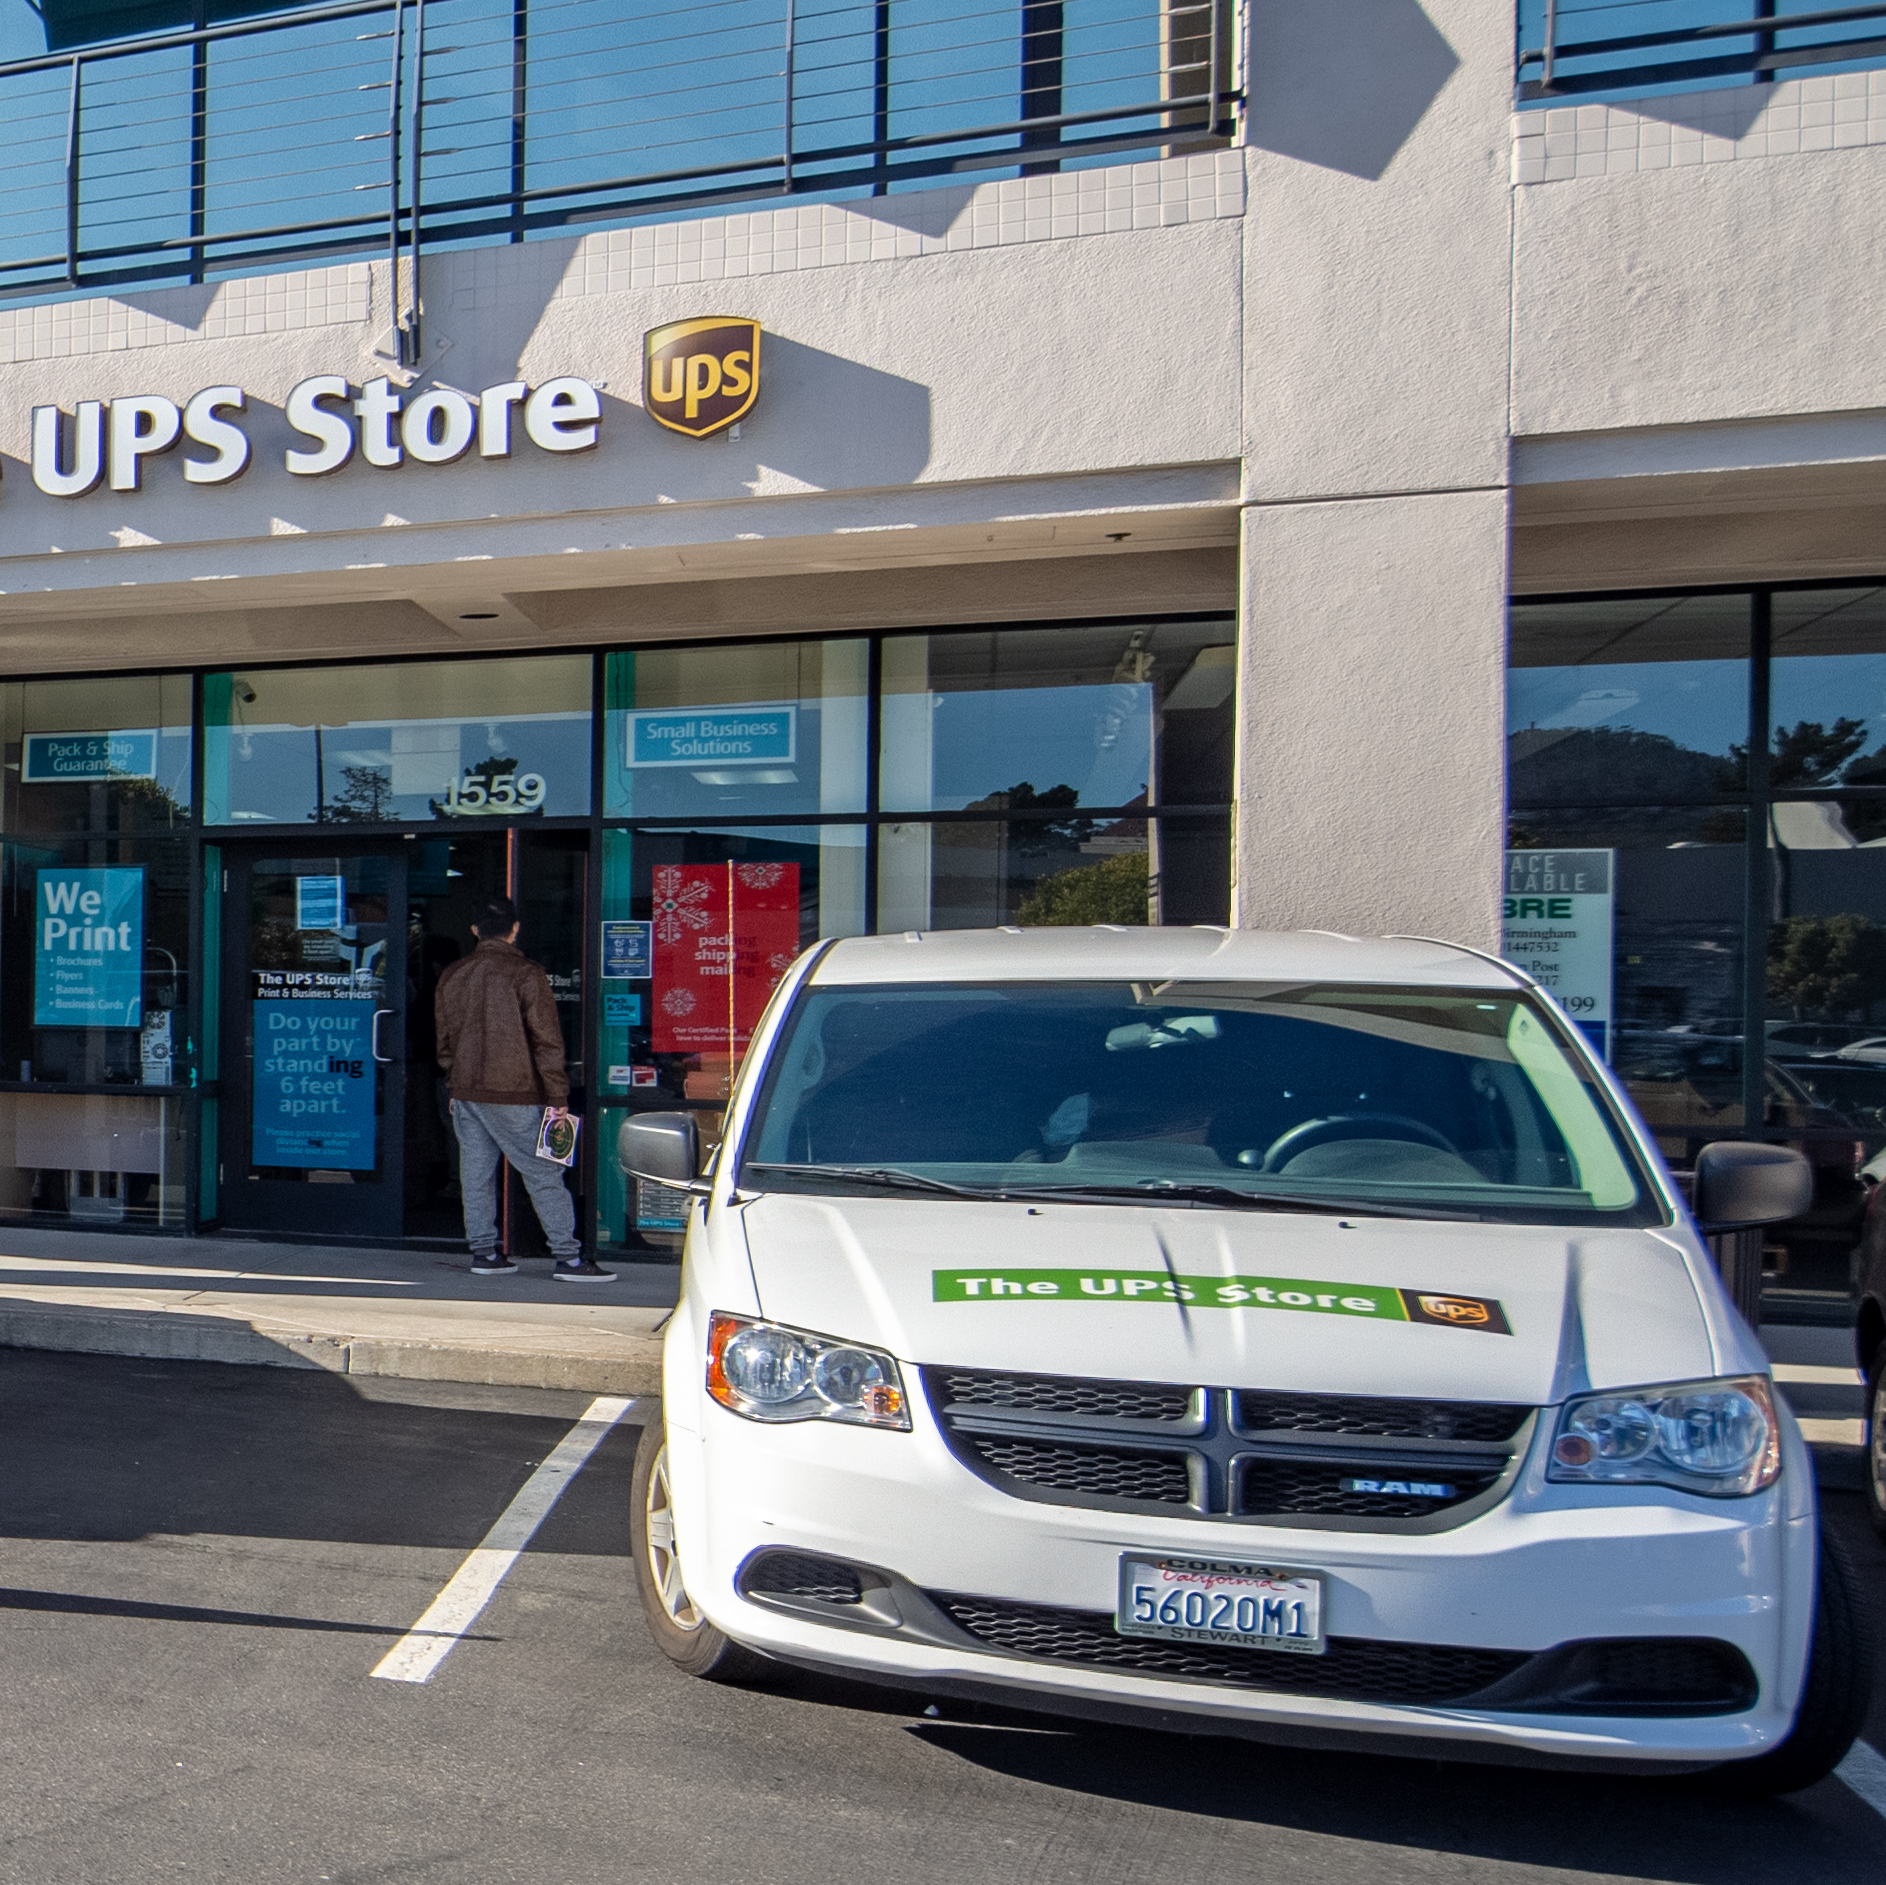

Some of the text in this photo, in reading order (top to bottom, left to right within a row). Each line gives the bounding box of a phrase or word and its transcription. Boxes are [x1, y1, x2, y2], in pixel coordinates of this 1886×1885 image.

[650, 349, 751, 419] ups
[31, 385, 249, 498] UPS
[285, 373, 603, 475] Store
[646, 720, 778, 740] Small Business
[47, 739, 135, 759] Pack & Ship
[670, 739, 753, 756] Solutions
[53, 757, 127, 772] Guarantee
[446, 772, 548, 812] 1559
[1510, 854, 1556, 874] ACE
[1510, 873, 1586, 892] LABLE
[43, 881, 102, 915] We
[1503, 897, 1573, 919] BRE
[43, 916, 132, 952] Print
[1503, 926, 1577, 941] irmingham
[695, 948, 759, 964] shippng
[1504, 941, 1559, 953] 1447532
[56, 955, 104, 967] Brochures
[1531, 960, 1560, 972] Post
[56, 969, 84, 982] Flyers
[257, 972, 351, 985] The UPS Store
[55, 983, 95, 995] Banners
[257, 987, 373, 1000] Print & Business Services
[55, 998, 124, 1010] Business Cards
[606, 996, 627, 1004] Pack
[616, 1003, 636, 1012] Ship
[268, 1012, 359, 1035] Do your
[273, 1033, 355, 1057] part by
[264, 1055, 363, 1079] standing
[280, 1075, 347, 1095] 6 feet
[279, 1096, 347, 1118] apart.
[957, 1277, 1485, 1324] The UPS Store ups
[1352, 1479, 1445, 1497] RAM
[1166, 1558, 1274, 1577] COLMA
[1162, 1569, 1287, 1591] California
[1134, 1585, 1309, 1639] 56020M1
[1170, 1626, 1270, 1646] STEWART
